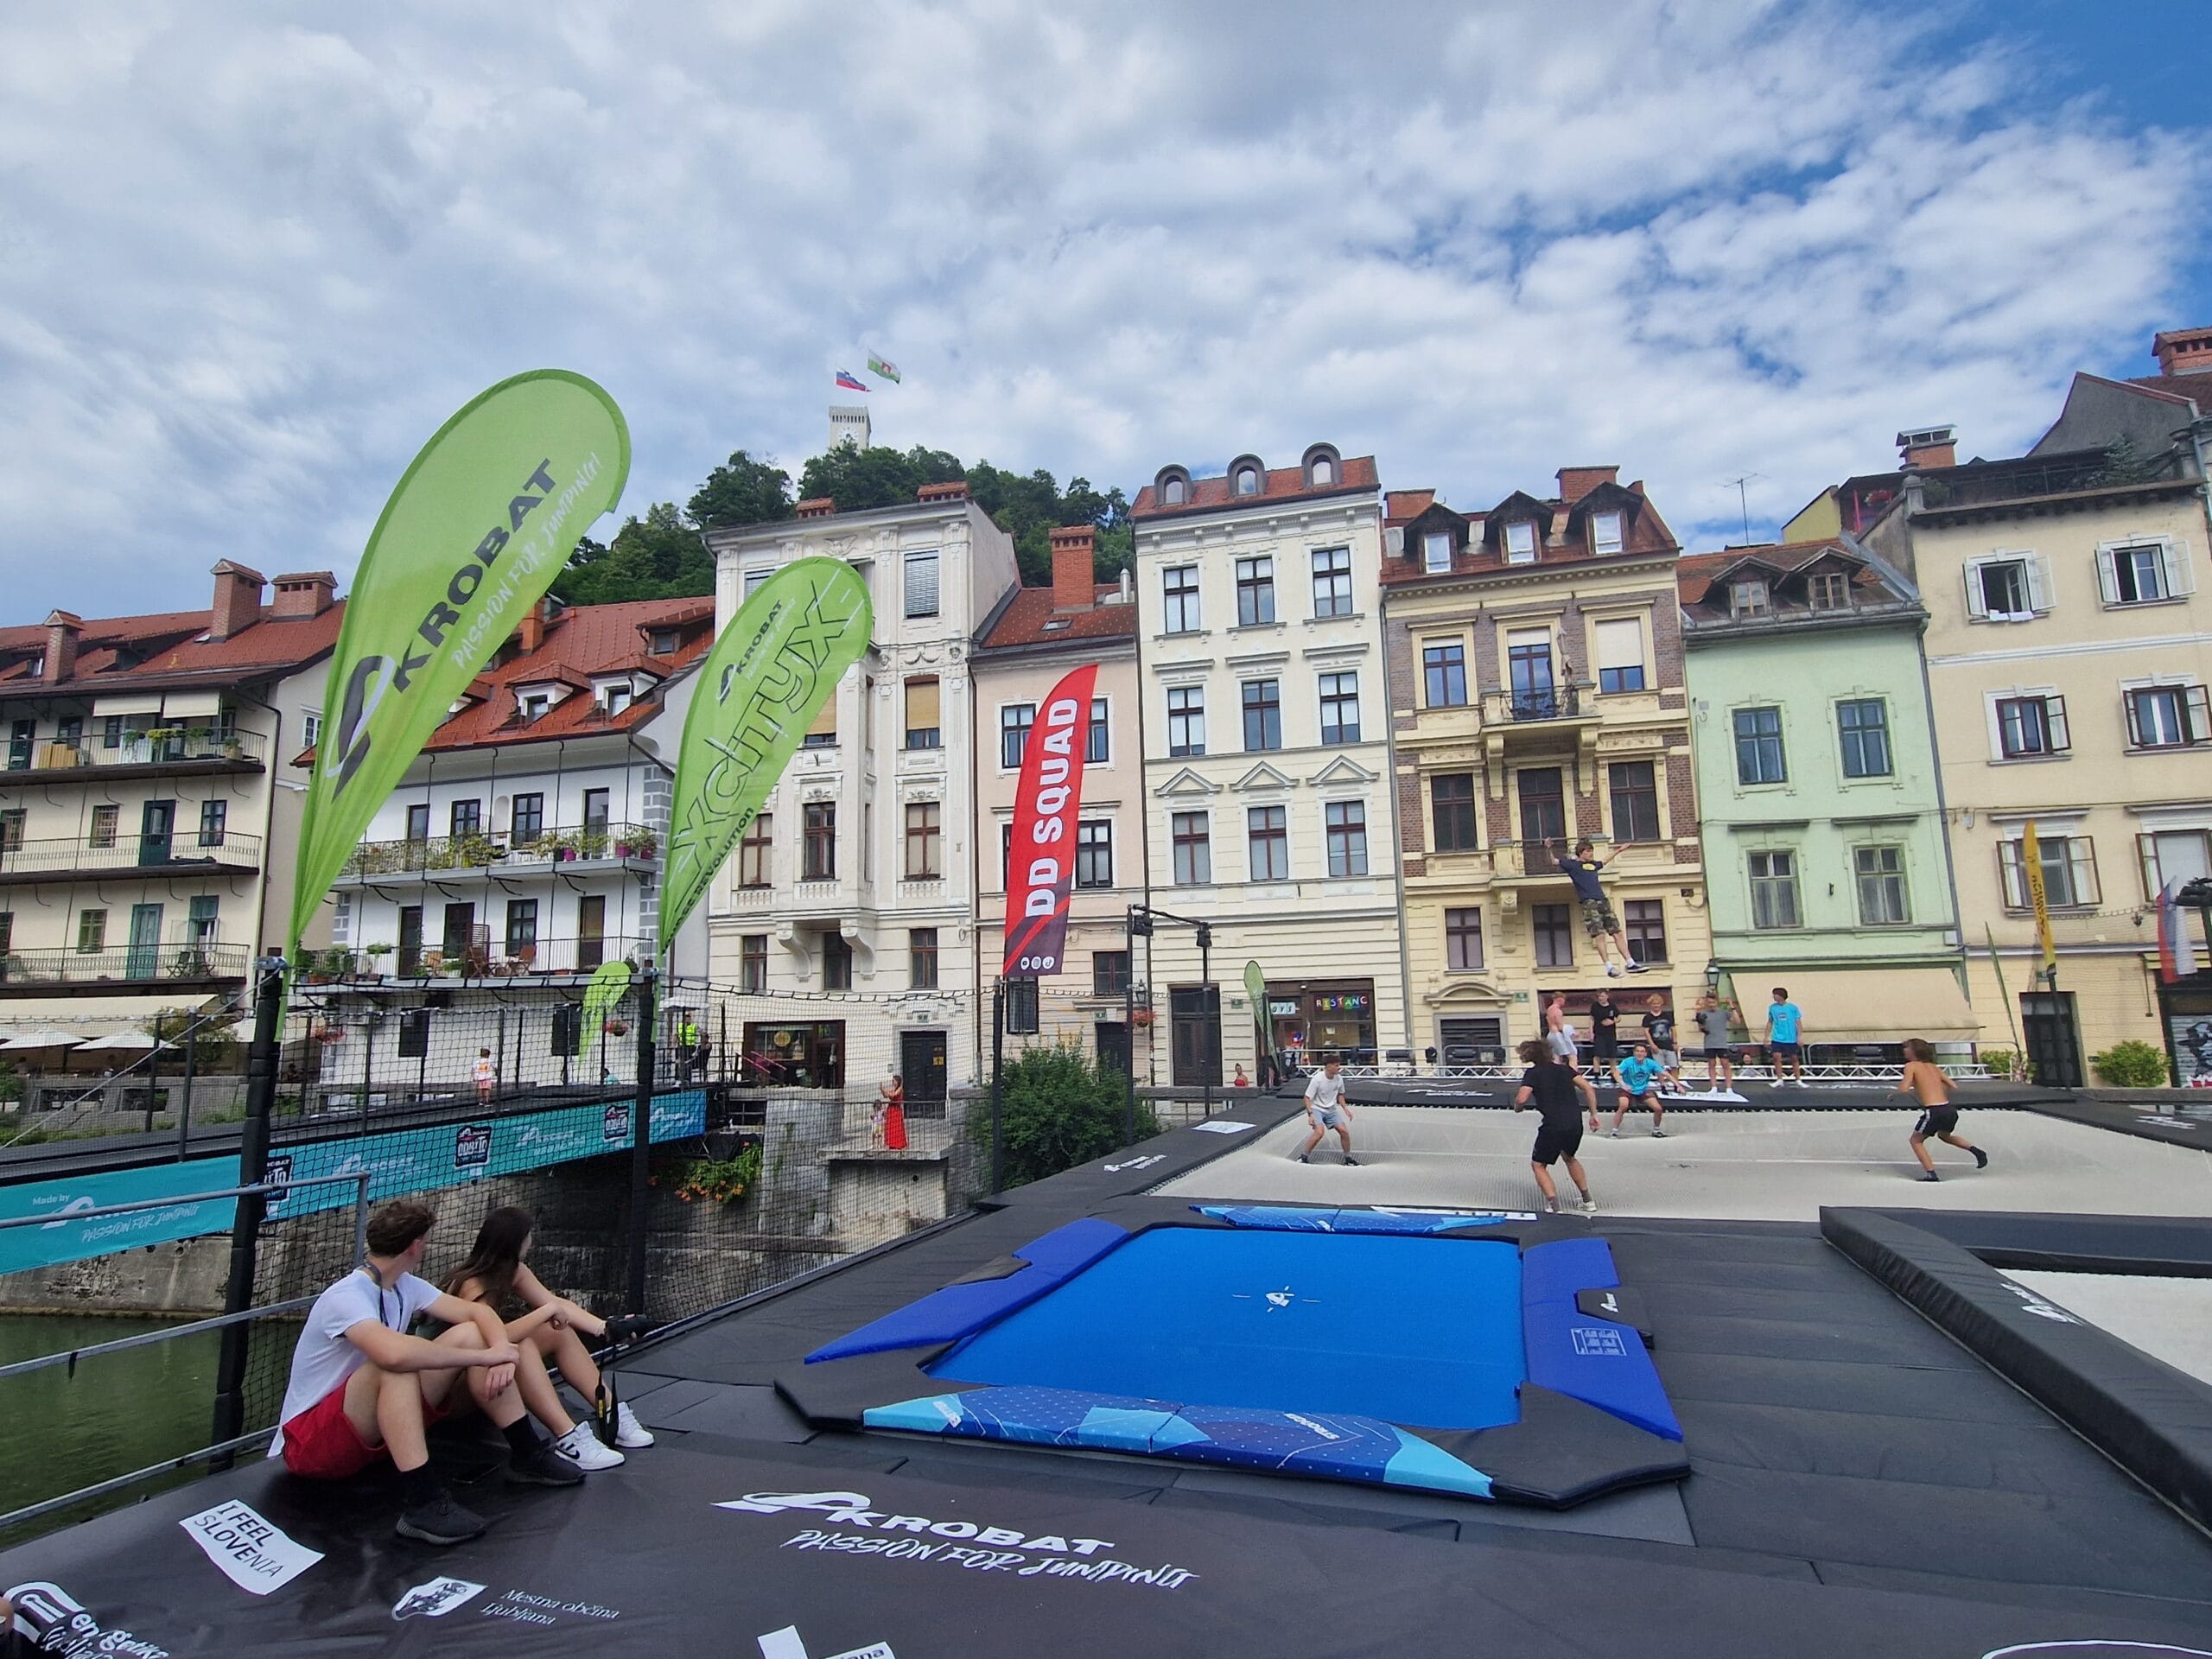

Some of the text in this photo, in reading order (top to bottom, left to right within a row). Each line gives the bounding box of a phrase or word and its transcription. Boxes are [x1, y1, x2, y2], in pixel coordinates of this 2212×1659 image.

[451, 579, 515, 671] PASSION
[508, 541, 545, 586] FOR
[1025, 697, 1080, 918] DD SQUAD
[1315, 995, 1369, 1008] RISTANC
[33, 1193, 70, 1205] Made by
[82, 1217, 132, 1243] PASSION
[132, 1213, 155, 1229] FOR
[217, 1504, 274, 1547] I FEEL
[194, 1515, 284, 1577] SLOVENIA
[779, 1529, 950, 1561] PASSION
[938, 1548, 1027, 1578] FOR
[480, 1602, 556, 1625] Ljubljana
[500, 1589, 620, 1619] Mestna občina
